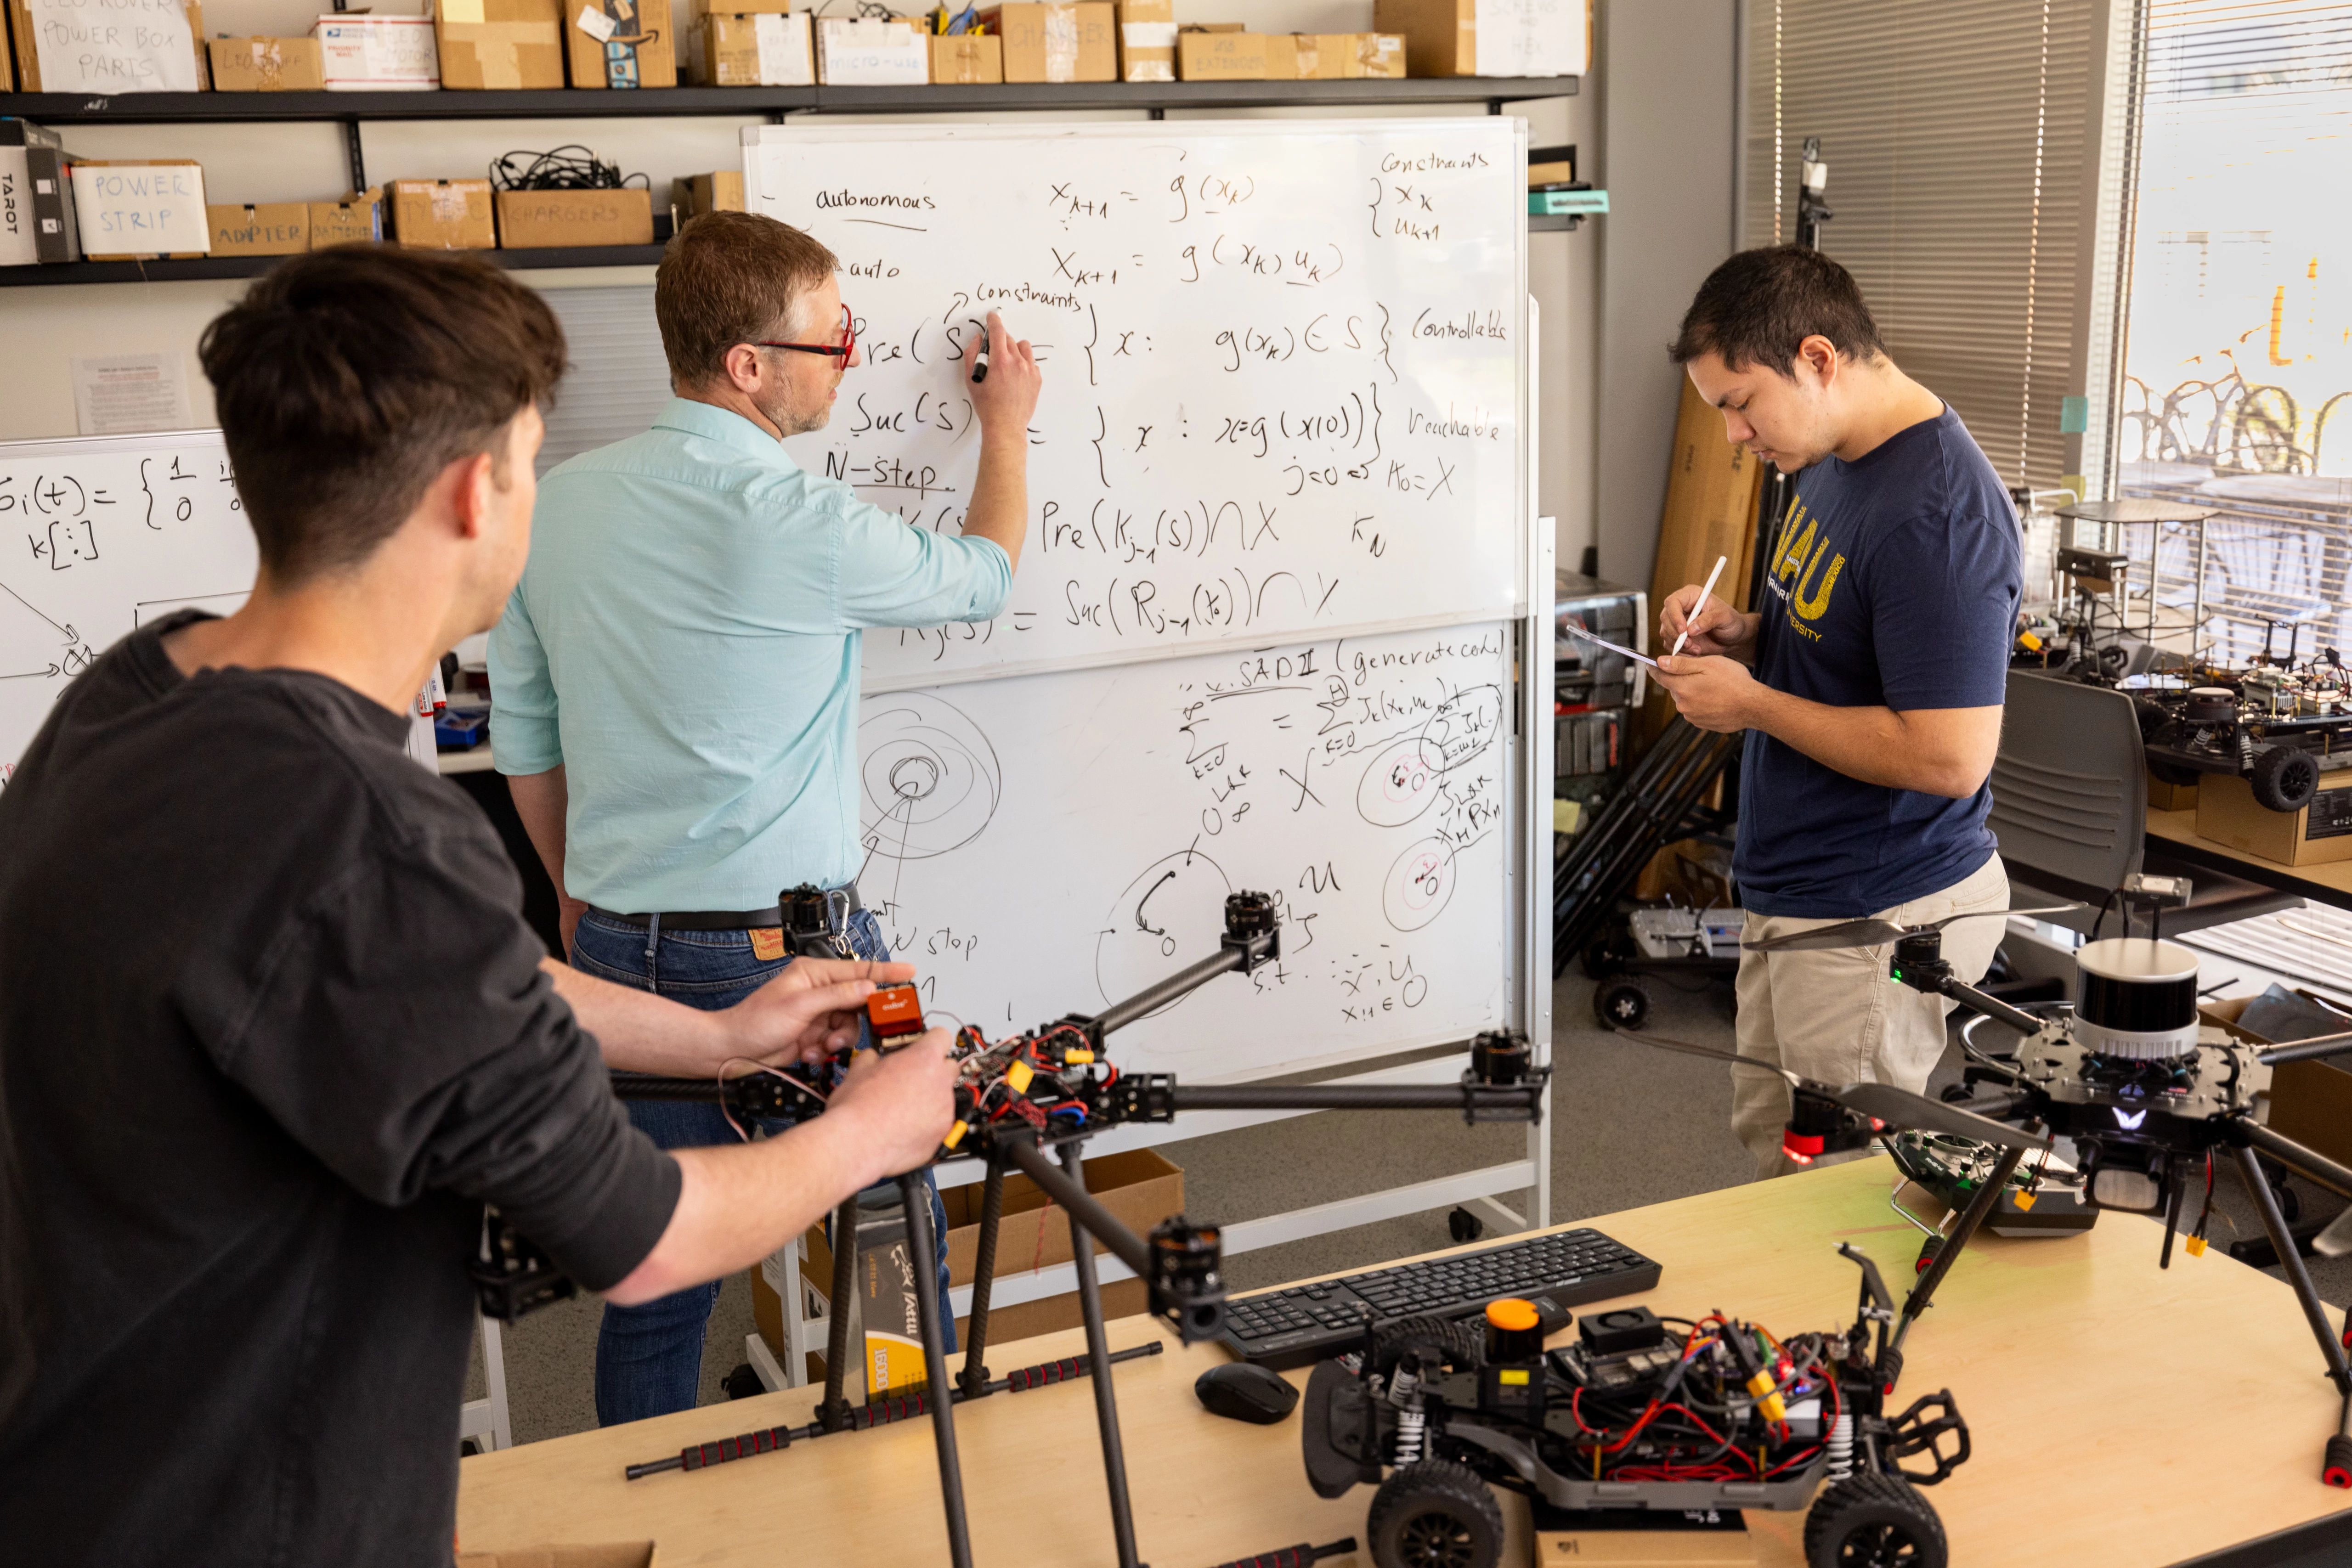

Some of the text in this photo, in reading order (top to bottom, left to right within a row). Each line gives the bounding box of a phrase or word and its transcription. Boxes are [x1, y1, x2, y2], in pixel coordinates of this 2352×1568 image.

[44, 20, 175, 49] POWER BOX
[79, 54, 154, 80] PARTS
[96, 175, 190, 198] POWER
[2, 174, 17, 235] TAROT
[816, 189, 936, 209] autonomous
[100, 210, 171, 231] STRIP
[511, 204, 619, 222] CHARGERS
[850, 259, 900, 278] auto
[1828, 556, 1846, 589] MEXICO
[874, 1346, 889, 1390] 16000
